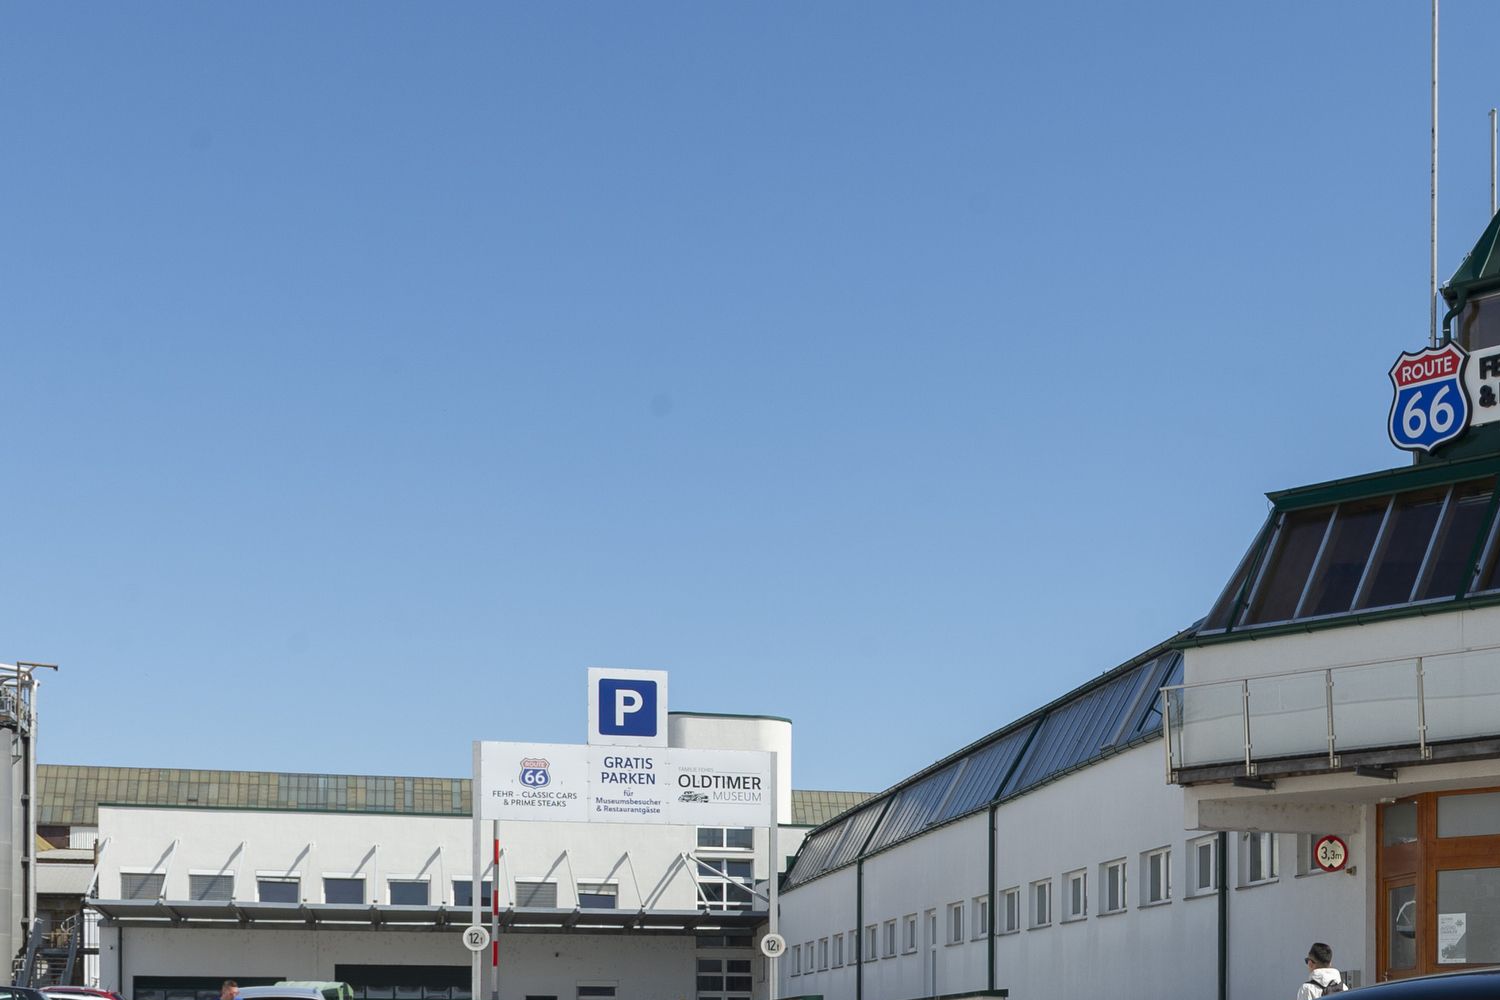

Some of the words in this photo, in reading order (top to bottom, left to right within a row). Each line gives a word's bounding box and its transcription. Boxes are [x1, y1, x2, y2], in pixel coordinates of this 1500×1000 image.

[1402, 355, 1453, 380] ROUTE
[1479, 386, 1497, 408] &
[1402, 385, 1455, 439] 66
[615, 689, 643, 726] P
[603, 756, 653, 769] GRATIS
[525, 770, 545, 784] 66
[601, 772, 656, 785] PARKEN
[678, 774, 761, 790] OLDTIMER
[521, 791, 555, 799] CLASSIC
[595, 797, 661, 805] Museumsbesucher
[713, 791, 761, 802] MUSEUM
[603, 805, 660, 815] Restaurantgäste
